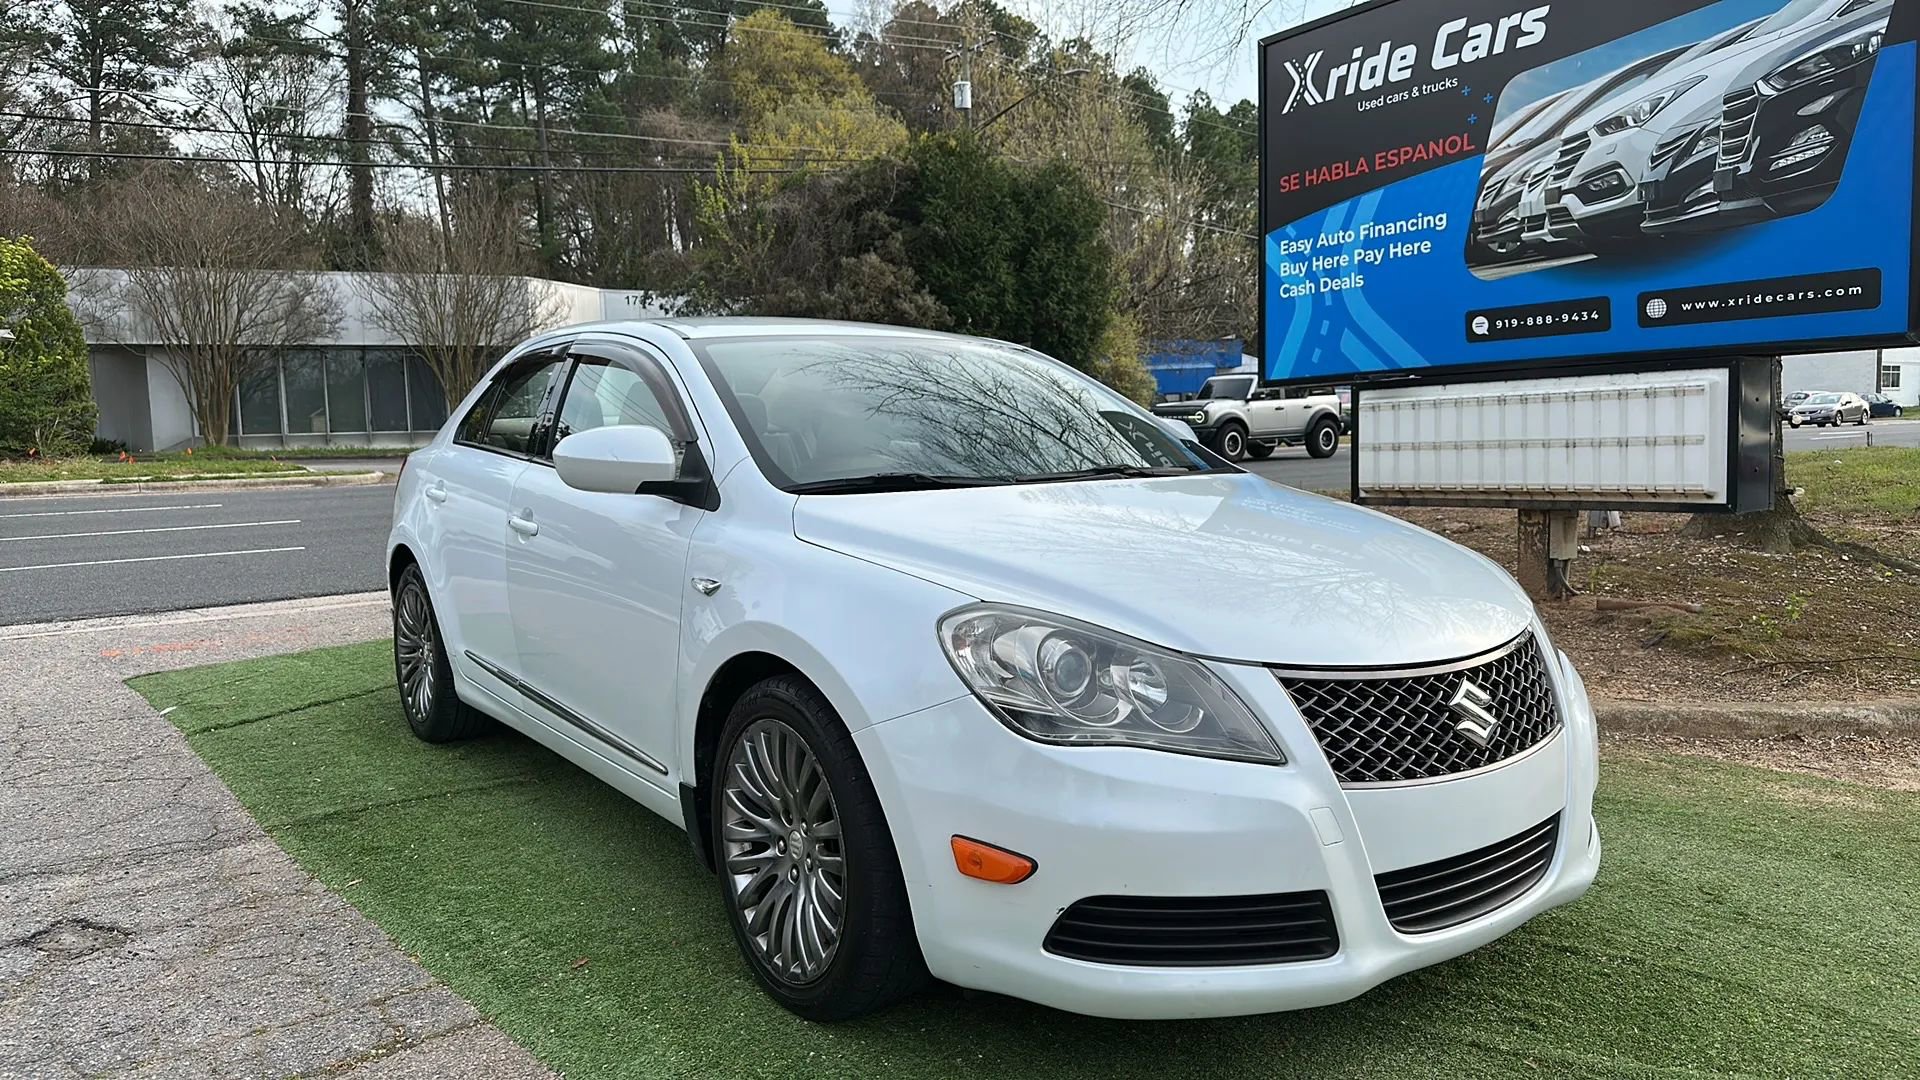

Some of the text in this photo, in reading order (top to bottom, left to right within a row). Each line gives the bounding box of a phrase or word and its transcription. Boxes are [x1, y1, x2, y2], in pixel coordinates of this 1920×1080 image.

[1282, 5, 1550, 115] Xride Cars
[1357, 77, 1459, 112] Used cars & trucks
[1279, 132, 1476, 192] SE HABLA ESPANOL
[1280, 212, 1448, 257] Easy Auto Financing
[1280, 240, 1432, 277] Buy Here Pay Here
[1280, 272, 1364, 299] Cash Deals
[1681, 284, 1863, 312] www.xridecars.com
[1495, 310, 1600, 330] 919-888-9434
